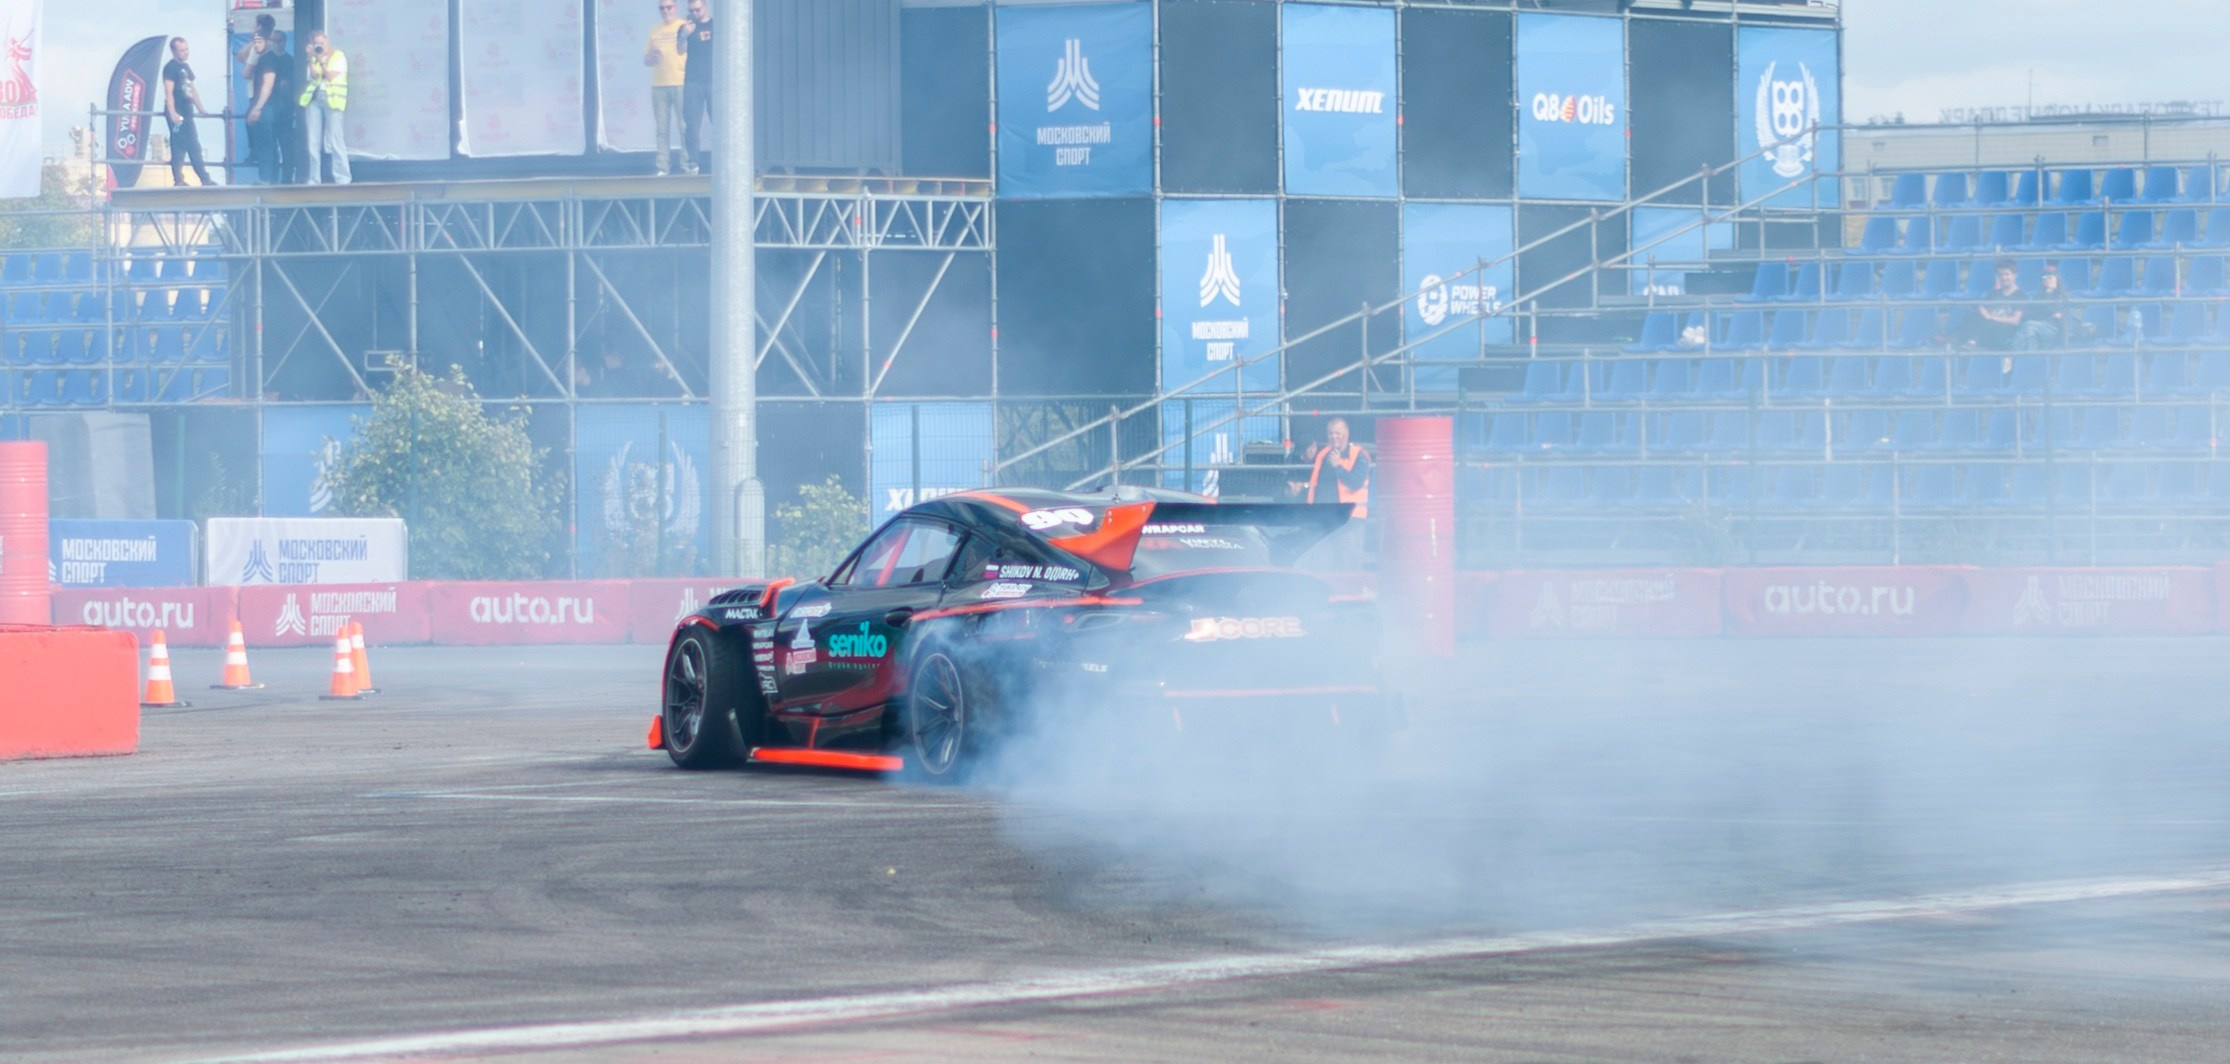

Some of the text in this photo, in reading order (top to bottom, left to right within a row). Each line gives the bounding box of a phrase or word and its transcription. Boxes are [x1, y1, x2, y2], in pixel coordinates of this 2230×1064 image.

[120, 79, 135, 132] YUA ADV
[1295, 88, 1383, 113] XENUM
[1532, 92, 1615, 125] Q8 Oils
[1037, 121, 1111, 145] МОСКОВСКИЙ
[1056, 147, 1091, 166] СПОРТ
[1450, 285, 1497, 300] POWER
[1192, 316, 1249, 340] МОСКОВСКИЙ
[1206, 342, 1235, 361] СПОРТ
[62, 535, 157, 561] МОСКОВСКИЙ
[279, 534, 368, 561] МОСКОВСКИЙ
[62, 562, 107, 584] СПОРТ
[279, 562, 319, 583] СПОРТ
[999, 565, 1033, 579] SHIKOV
[310, 588, 397, 613] МОСКОВСКИЙ
[470, 592, 594, 624] auto.ru
[1764, 580, 1914, 616] auto.ru
[83, 597, 194, 629] auto.ru
[828, 620, 887, 658] seniko
